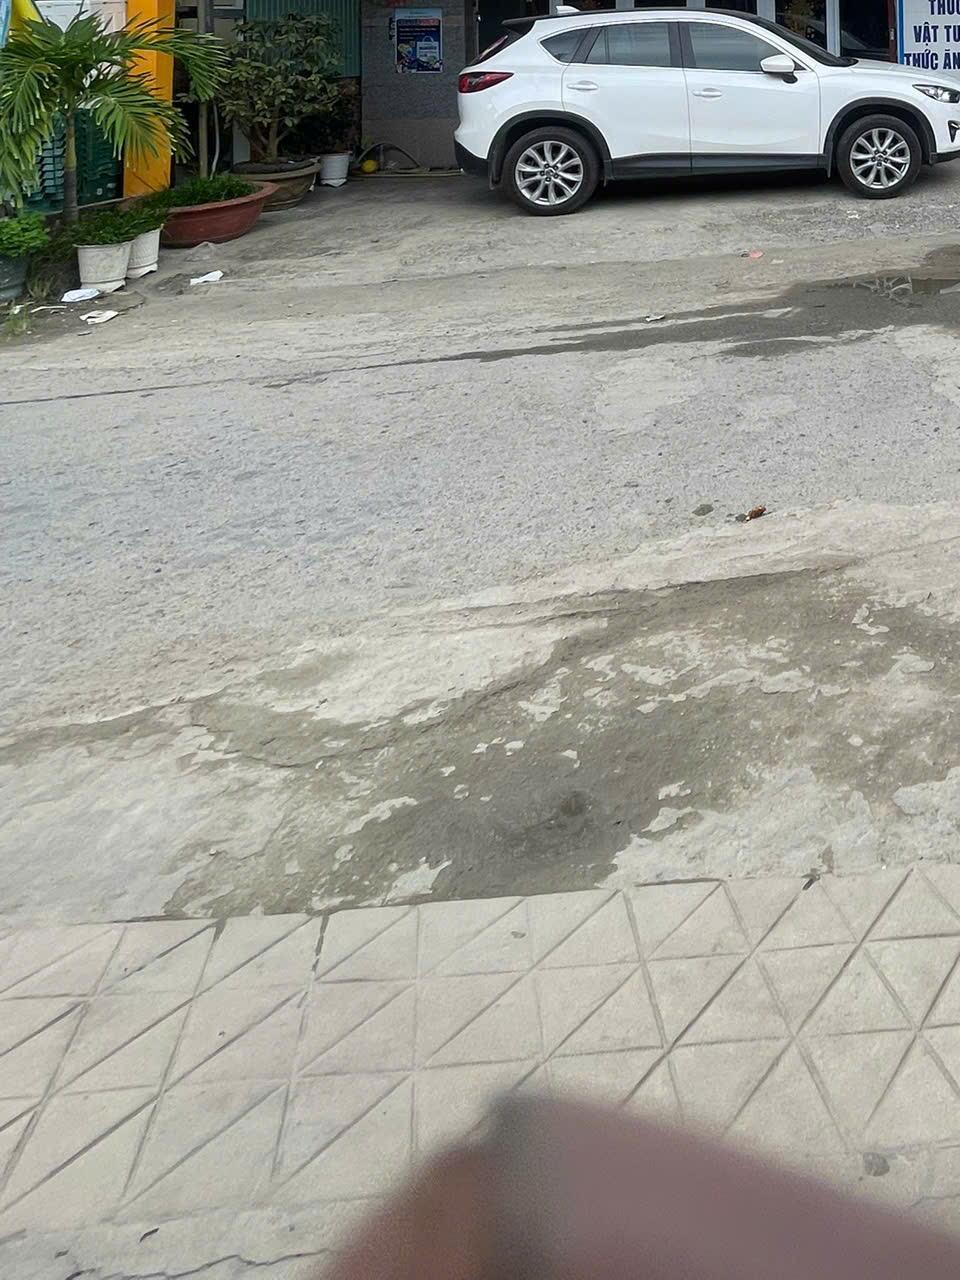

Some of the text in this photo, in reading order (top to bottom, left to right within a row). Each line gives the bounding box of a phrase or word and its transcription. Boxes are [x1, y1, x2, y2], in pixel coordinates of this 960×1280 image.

[913, 22, 939, 46] VẬT
[904, 49, 939, 70] THỨC
[943, 48, 960, 69] ĂN
